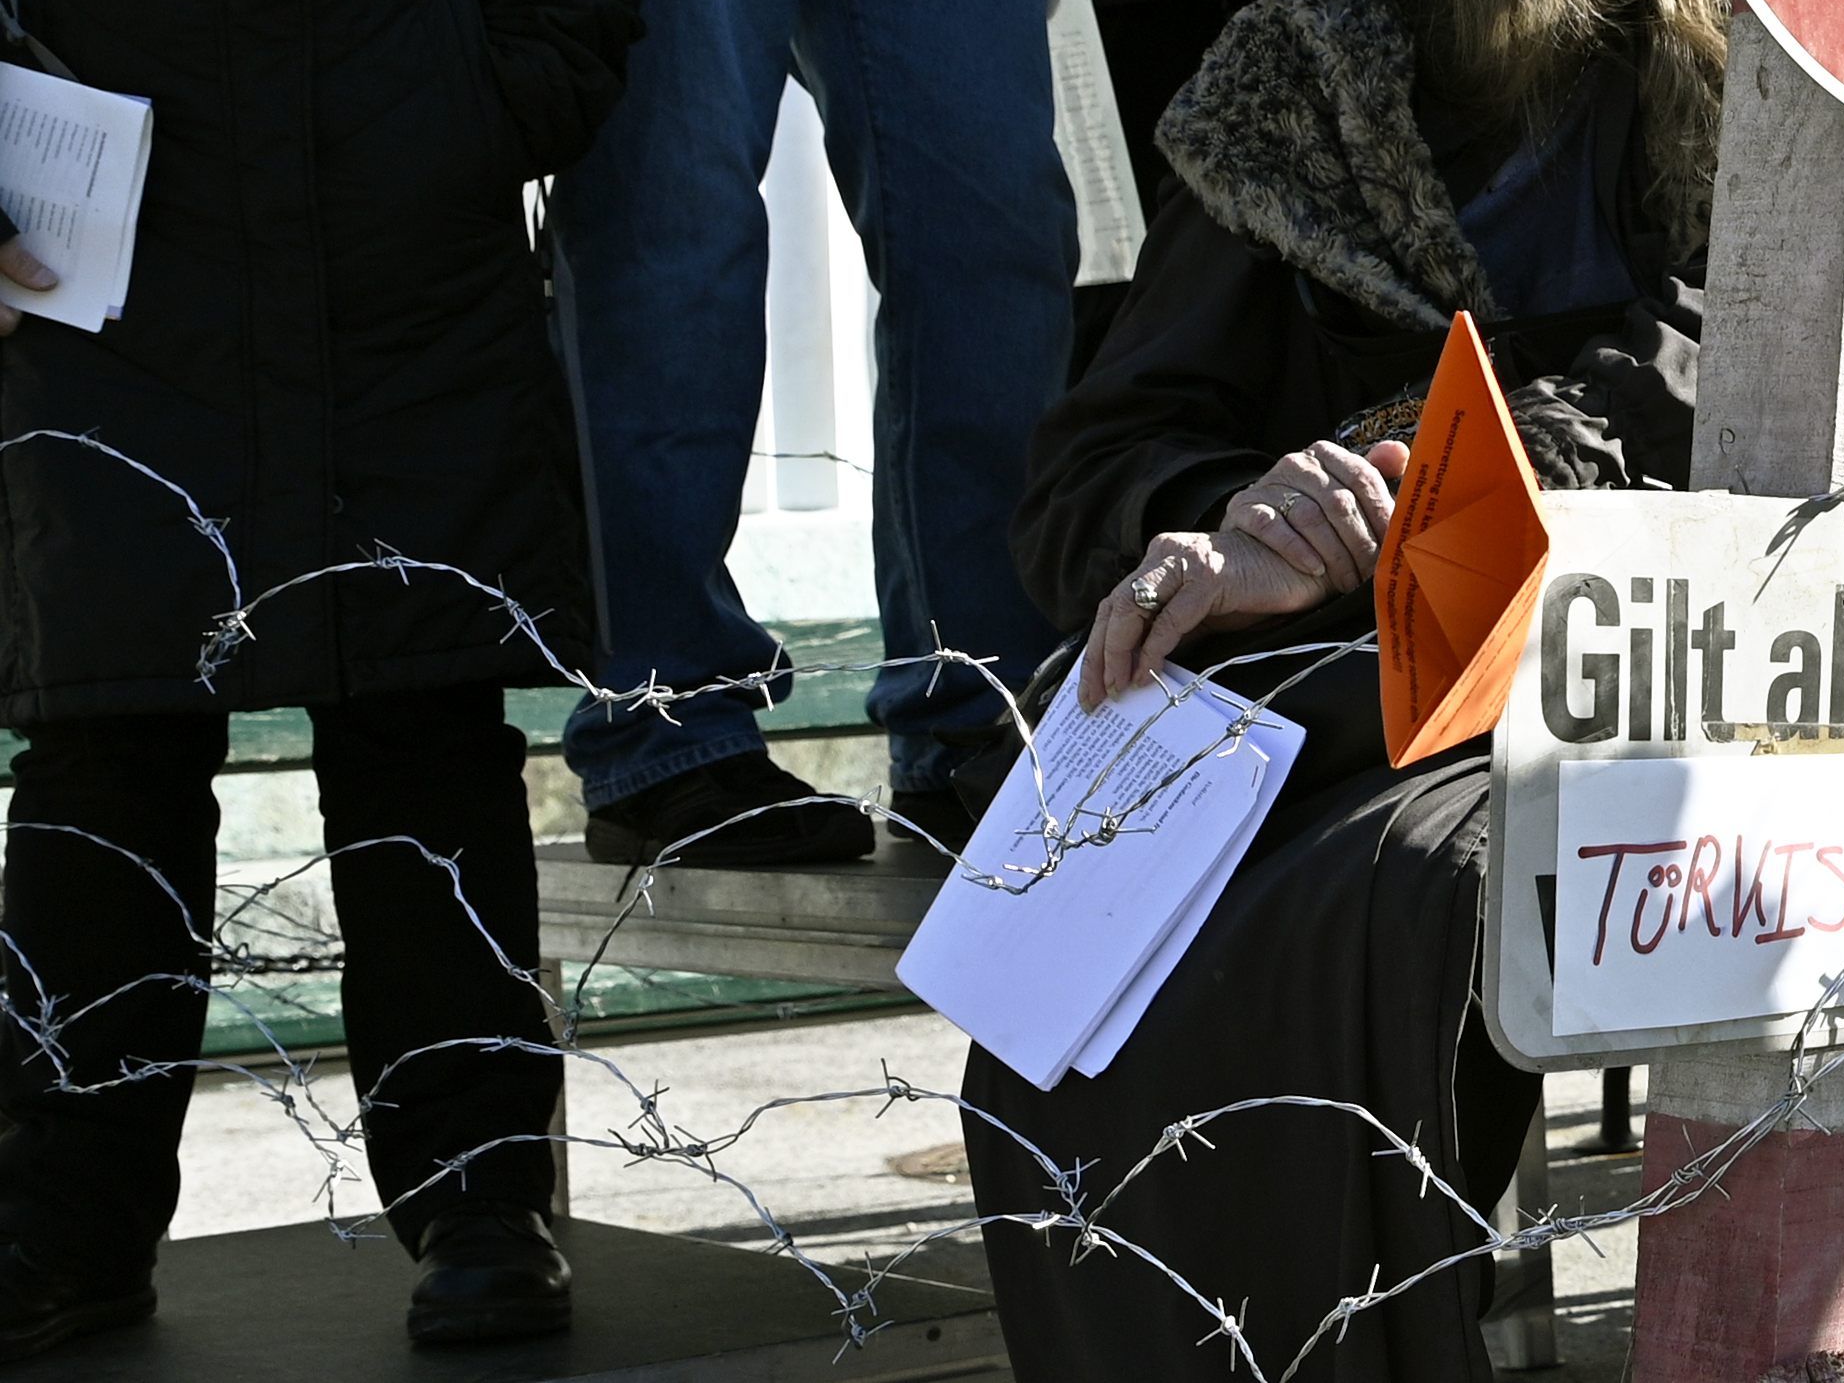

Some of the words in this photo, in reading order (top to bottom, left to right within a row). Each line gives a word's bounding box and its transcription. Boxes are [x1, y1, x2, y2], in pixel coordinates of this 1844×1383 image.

[1428, 408, 1464, 494] Seenotrettung
[1425, 496, 1438, 512] ist
[1540, 572, 1736, 744] Gilt
